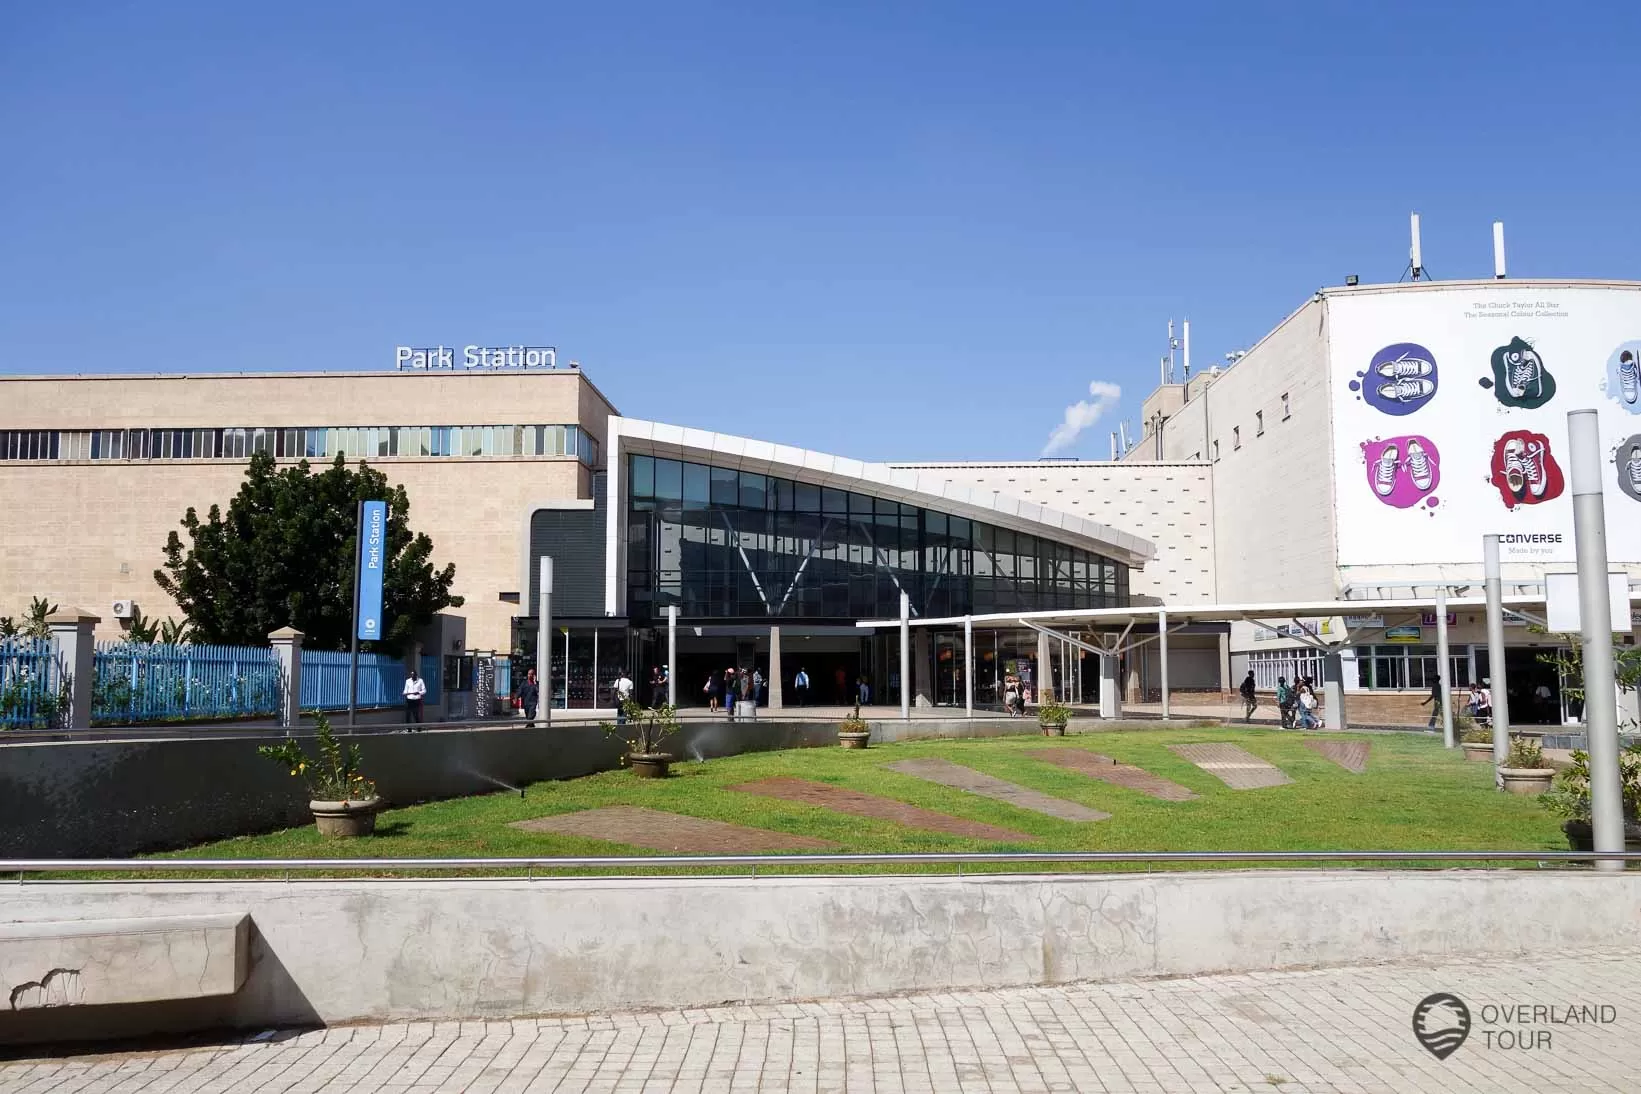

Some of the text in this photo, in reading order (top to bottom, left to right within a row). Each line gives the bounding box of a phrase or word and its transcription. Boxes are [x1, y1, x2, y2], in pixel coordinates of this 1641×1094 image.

[396, 345, 556, 369] Park Station
[368, 509, 380, 569] Park Station
[1498, 534, 1562, 543] CONVERSE
[1530, 547, 1540, 555] by
[1541, 547, 1553, 555] you
